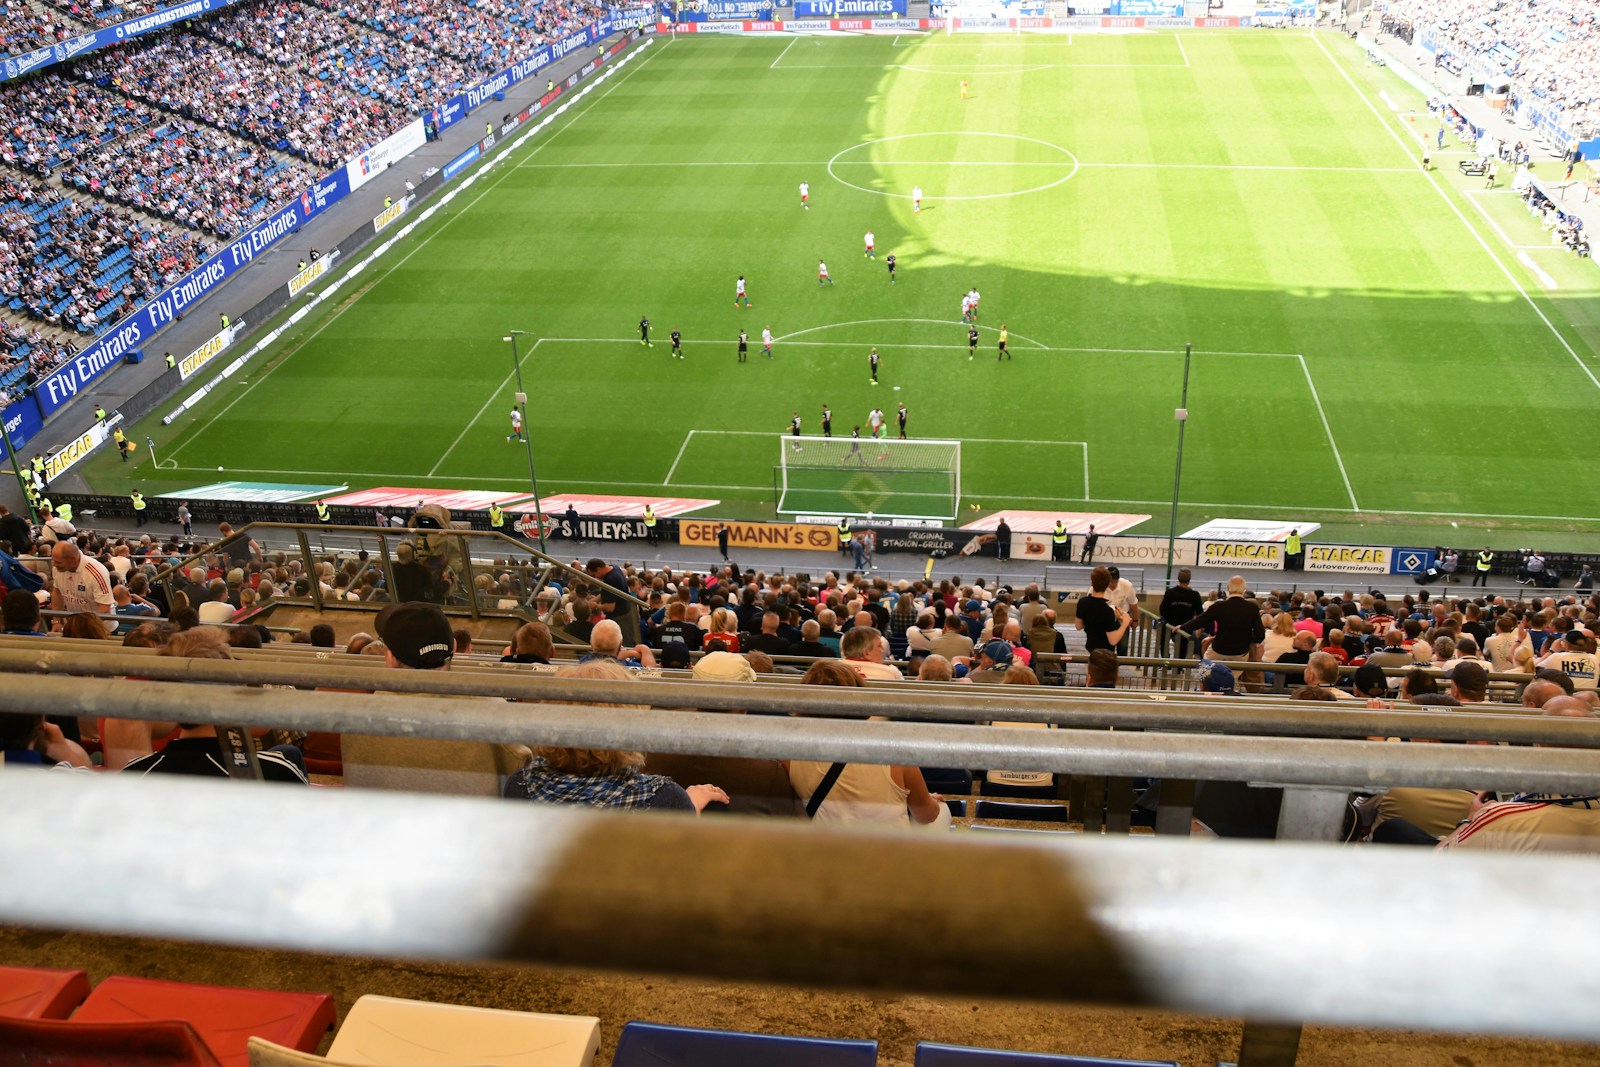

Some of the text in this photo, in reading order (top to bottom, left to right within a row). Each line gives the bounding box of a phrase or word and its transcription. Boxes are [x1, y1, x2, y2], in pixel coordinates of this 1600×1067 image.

[811, 0, 893, 15] Fly Emirates
[124, 3, 203, 35] VOLKSPARKSTADION
[751, 22, 775, 31] RINTI
[839, 21, 862, 29] RINTI
[552, 43, 564, 59] Fly
[563, 31, 587, 52] Emirates
[512, 51, 550, 81] Fly Emirates
[468, 74, 509, 107] Fly Emirates
[231, 209, 297, 266] Fly Emirates
[291, 261, 322, 294] STARCAR
[148, 258, 225, 327] Fly Emirates
[47, 321, 141, 404] Fly Emirates
[182, 336, 223, 376] STARCAR
[514, 517, 559, 532] Smily's
[562, 520, 650, 540] SILEYS.D
[882, 539, 955, 549] STADION-GRILLER
[908, 531, 945, 540] ORIGINAL
[1205, 543, 1280, 560] STARCAR
[1310, 547, 1386, 564] STARCAR
[1204, 558, 1280, 569] Autovermietung
[1309, 562, 1386, 573] Autovermietung
[1561, 660, 1585, 672] HSV
[1000, 772, 1031, 780] hamburger
